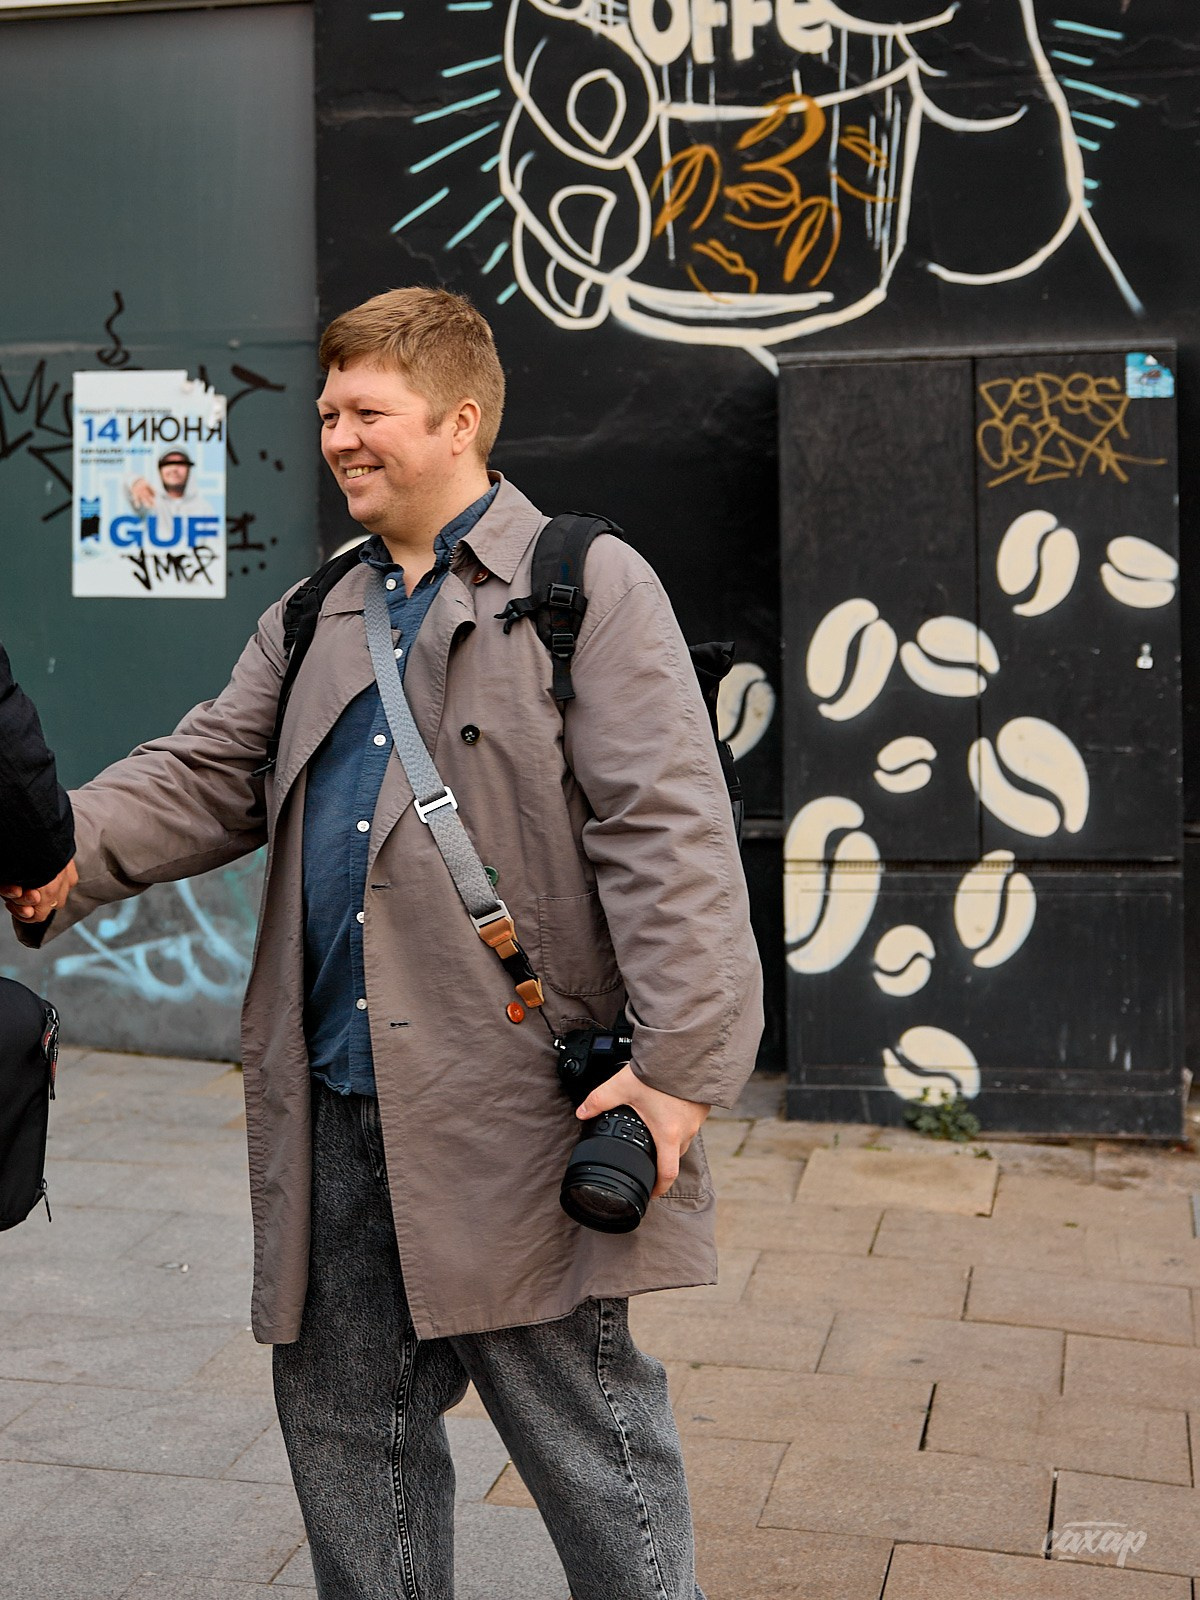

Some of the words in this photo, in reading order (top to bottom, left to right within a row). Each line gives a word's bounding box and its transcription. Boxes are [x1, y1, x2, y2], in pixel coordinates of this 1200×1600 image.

[82, 418, 121, 442] 14
[127, 417, 223, 442] ИЮНЯ
[109, 515, 220, 548] GUF
